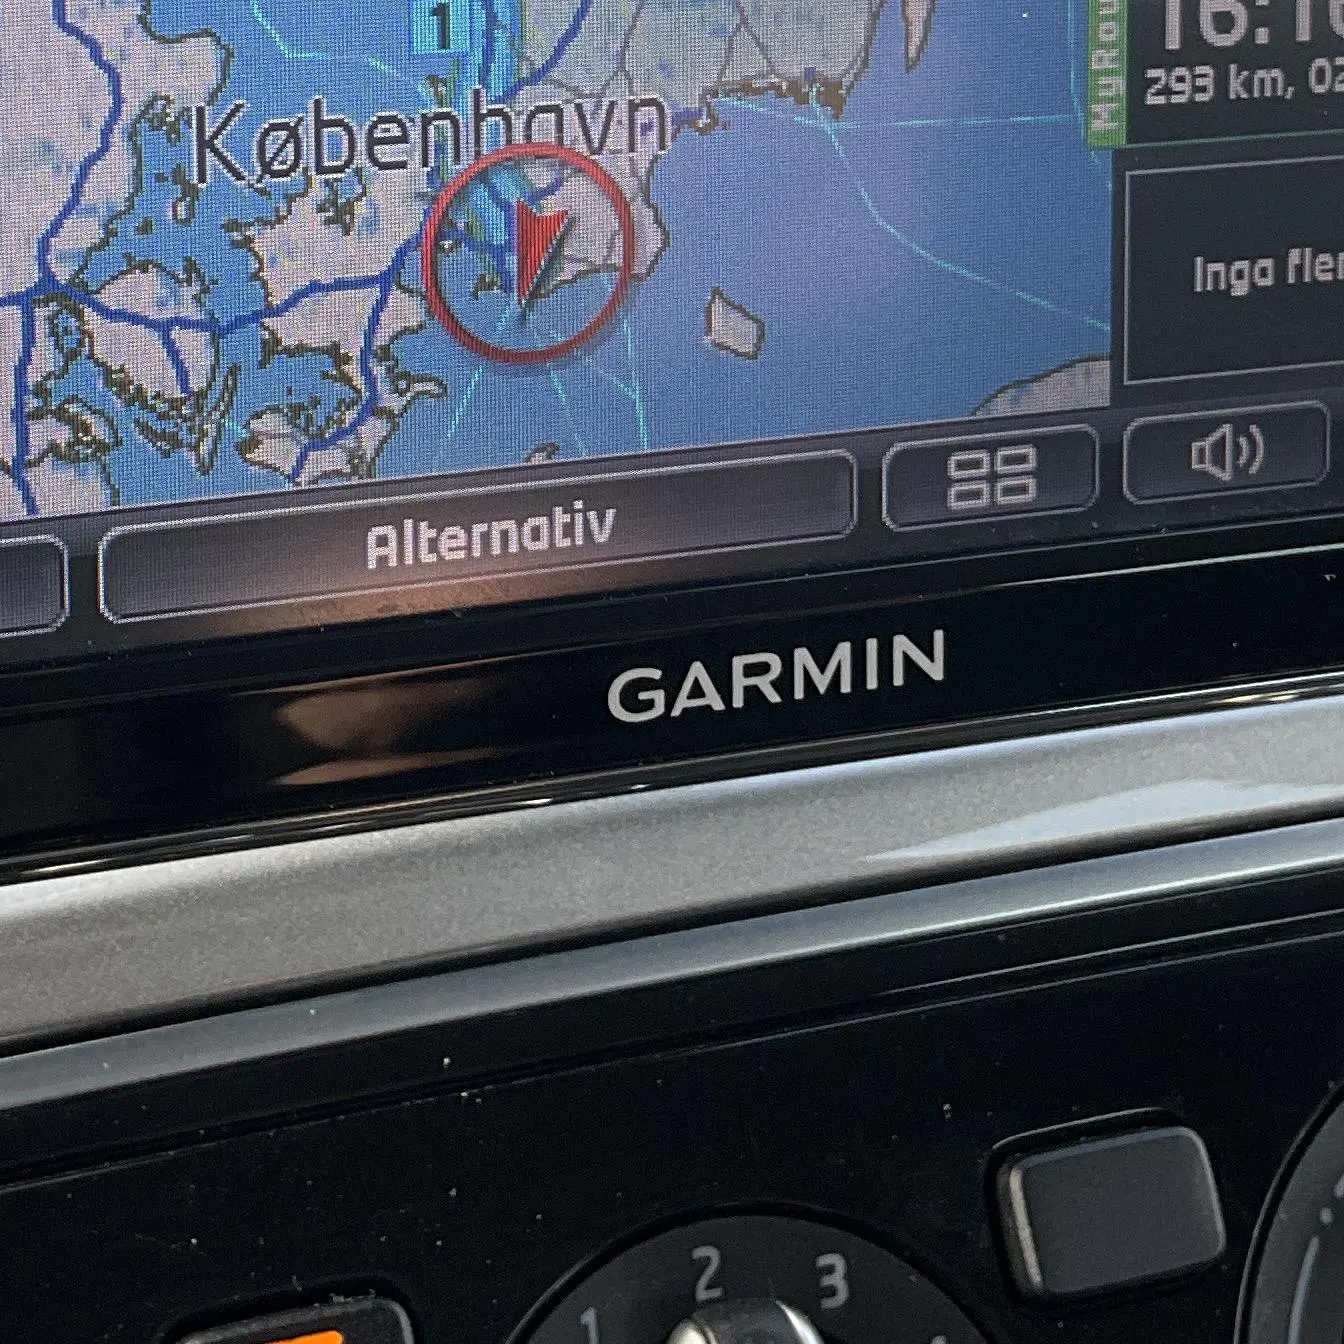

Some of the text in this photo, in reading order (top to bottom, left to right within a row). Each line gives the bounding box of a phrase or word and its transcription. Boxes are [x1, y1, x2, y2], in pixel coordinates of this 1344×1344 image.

[431, 3, 453, 51] 1
[1144, 64, 1215, 104] 293
[1229, 62, 1296, 100] km,
[194, 87, 669, 185] København
[1193, 255, 1274, 297] Inga
[365, 500, 618, 570] Alternativ
[606, 628, 946, 724] GARMIN
[690, 1244, 725, 1303] 2
[814, 1252, 851, 1311] 3
[578, 1305, 601, 1344] 1
